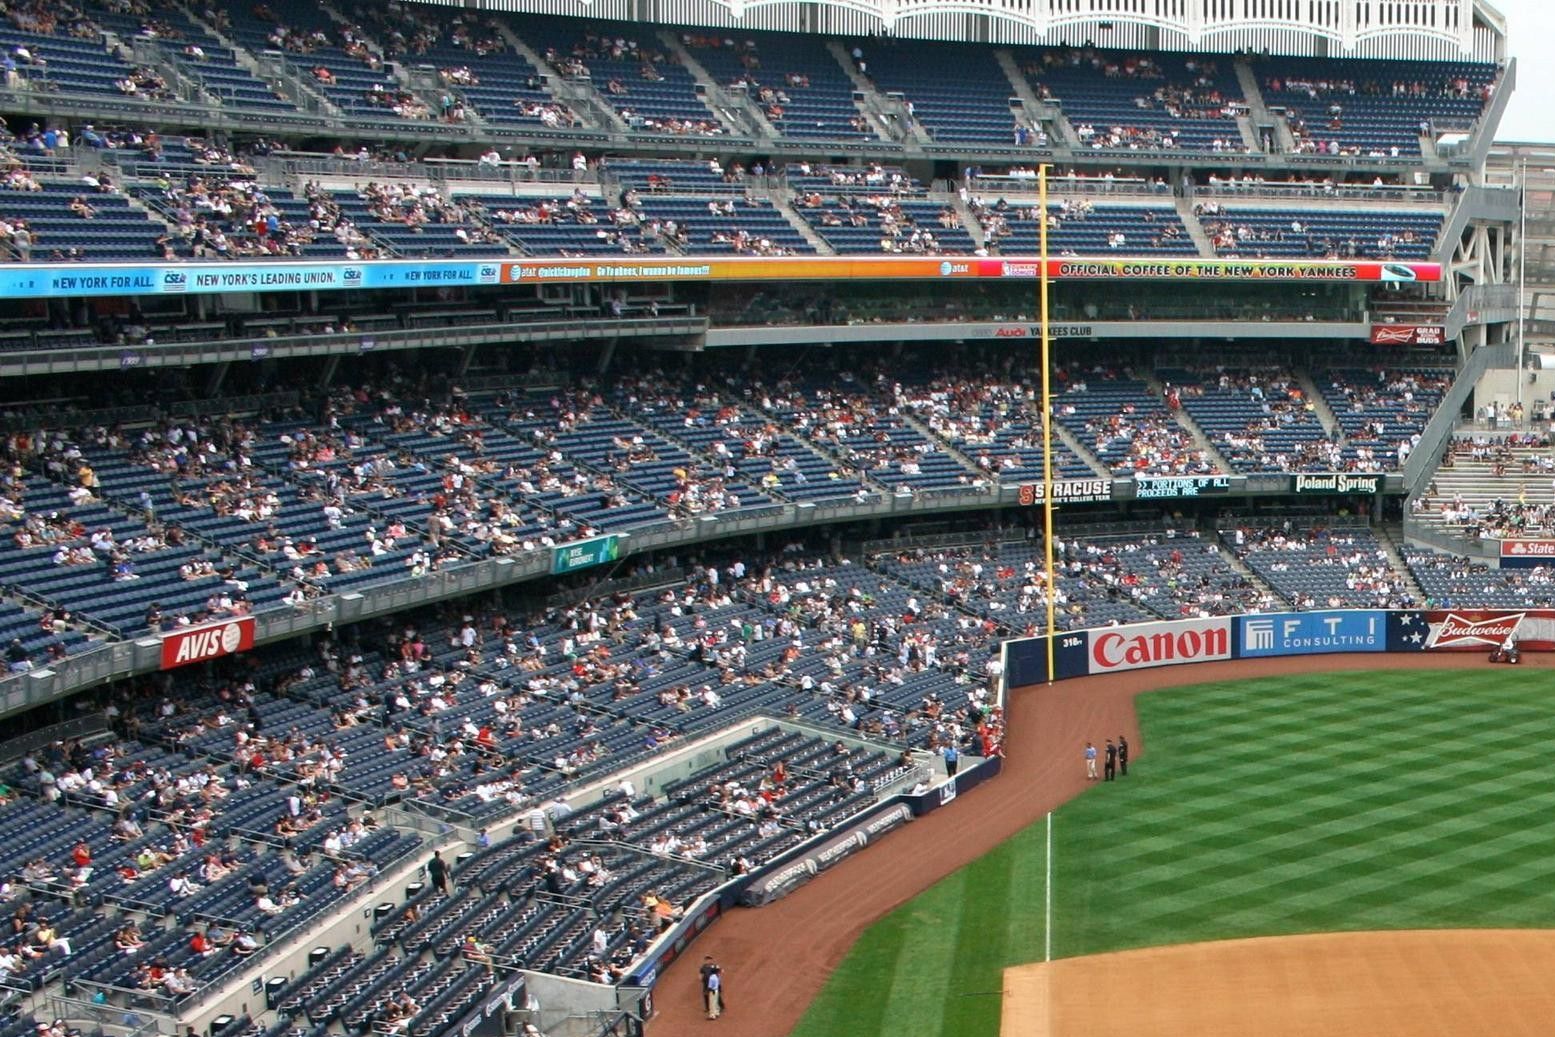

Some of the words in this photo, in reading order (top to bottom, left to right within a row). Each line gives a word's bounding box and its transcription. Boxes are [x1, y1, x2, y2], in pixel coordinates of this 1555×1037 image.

[423, 270, 442, 280] YORK
[442, 270, 458, 280] FOR
[1060, 265, 1116, 276] OFFICIAL
[1122, 265, 1170, 276] COFFEE
[1175, 266, 1192, 276] OF
[1196, 266, 1220, 276] THE
[1224, 266, 1254, 276] NEW
[1258, 266, 1295, 277] YORK
[1299, 266, 1356, 278] YANKEES
[53, 278, 76, 289] NEW
[80, 276, 108, 288] YORK
[110, 276, 130, 288] FOR
[133, 276, 155, 288] ALL.
[197, 274, 218, 286] NEW
[221, 274, 258, 285] YORK'S
[260, 272, 301, 284] LEADING
[304, 272, 336, 284] UNION.
[1070, 326, 1092, 336] CLUB
[1152, 480, 1189, 489] PORTIONS
[1198, 479, 1209, 487] OF
[1214, 478, 1230, 487] ALL
[1296, 475, 1336, 492] Poland
[1337, 475, 1376, 494] Spring
[1136, 488, 1178, 498] PROCEEDS
[1182, 488, 1198, 496] ARE
[175, 629, 222, 663] AVIS
[1093, 626, 1228, 668] Canon
[1284, 634, 1376, 648] CONSULTING
